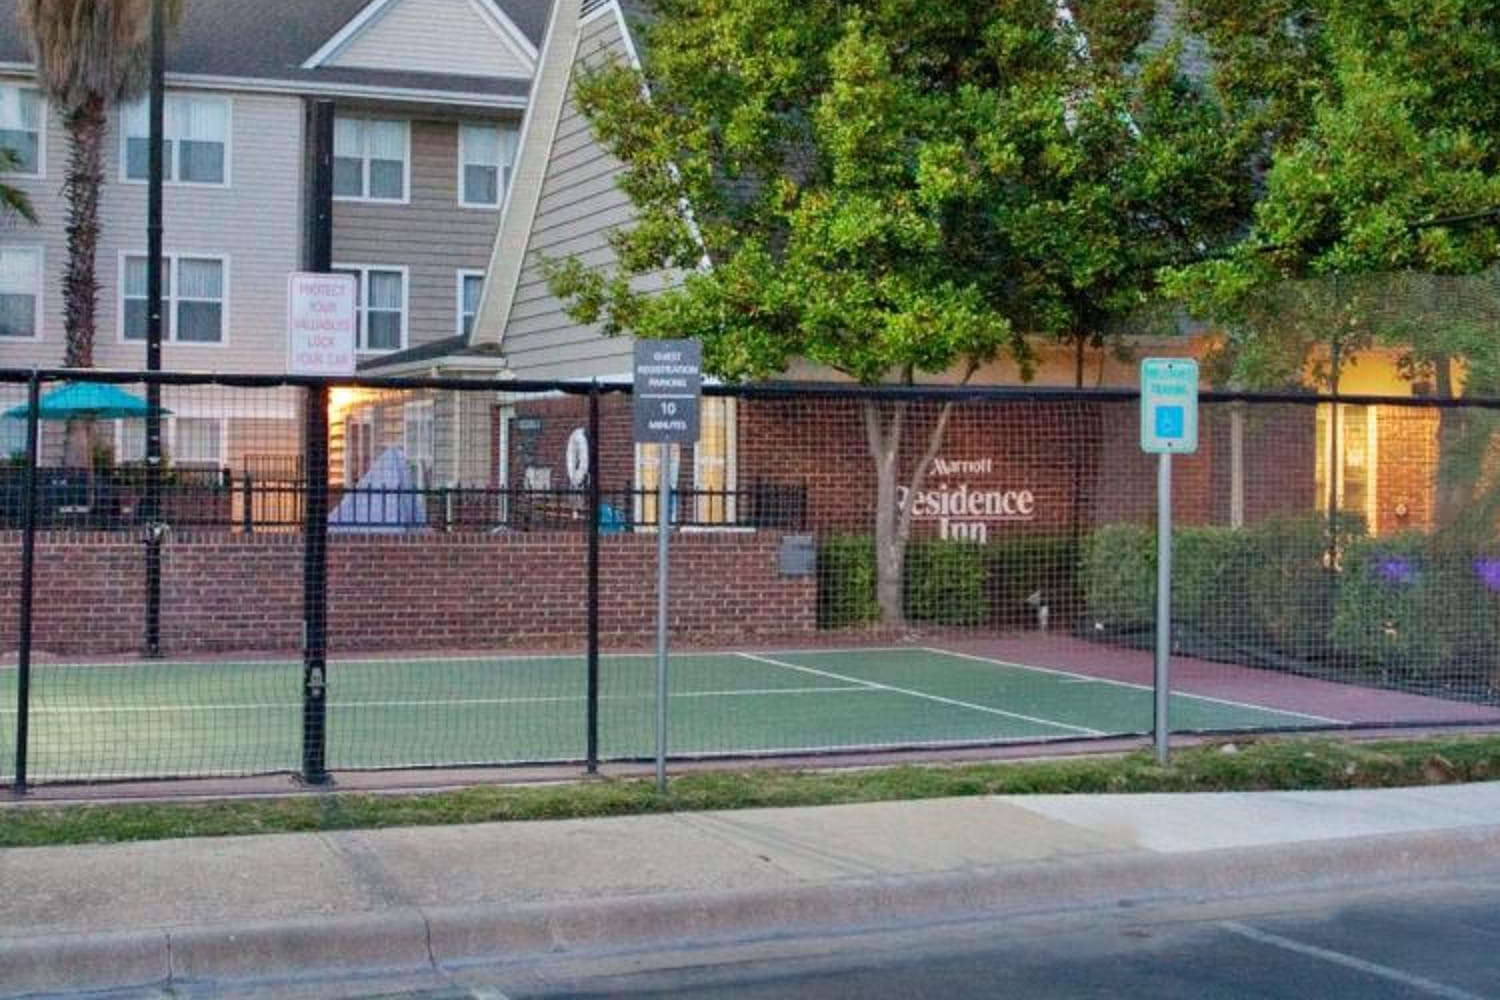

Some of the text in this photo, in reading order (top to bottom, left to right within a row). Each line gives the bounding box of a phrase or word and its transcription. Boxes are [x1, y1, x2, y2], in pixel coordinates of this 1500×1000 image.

[653, 351, 682, 361] GUEST
[661, 401, 677, 417] 10
[647, 420, 688, 431] MINUTES
[930, 457, 993, 476] Marriott
[940, 517, 988, 545] Inn
